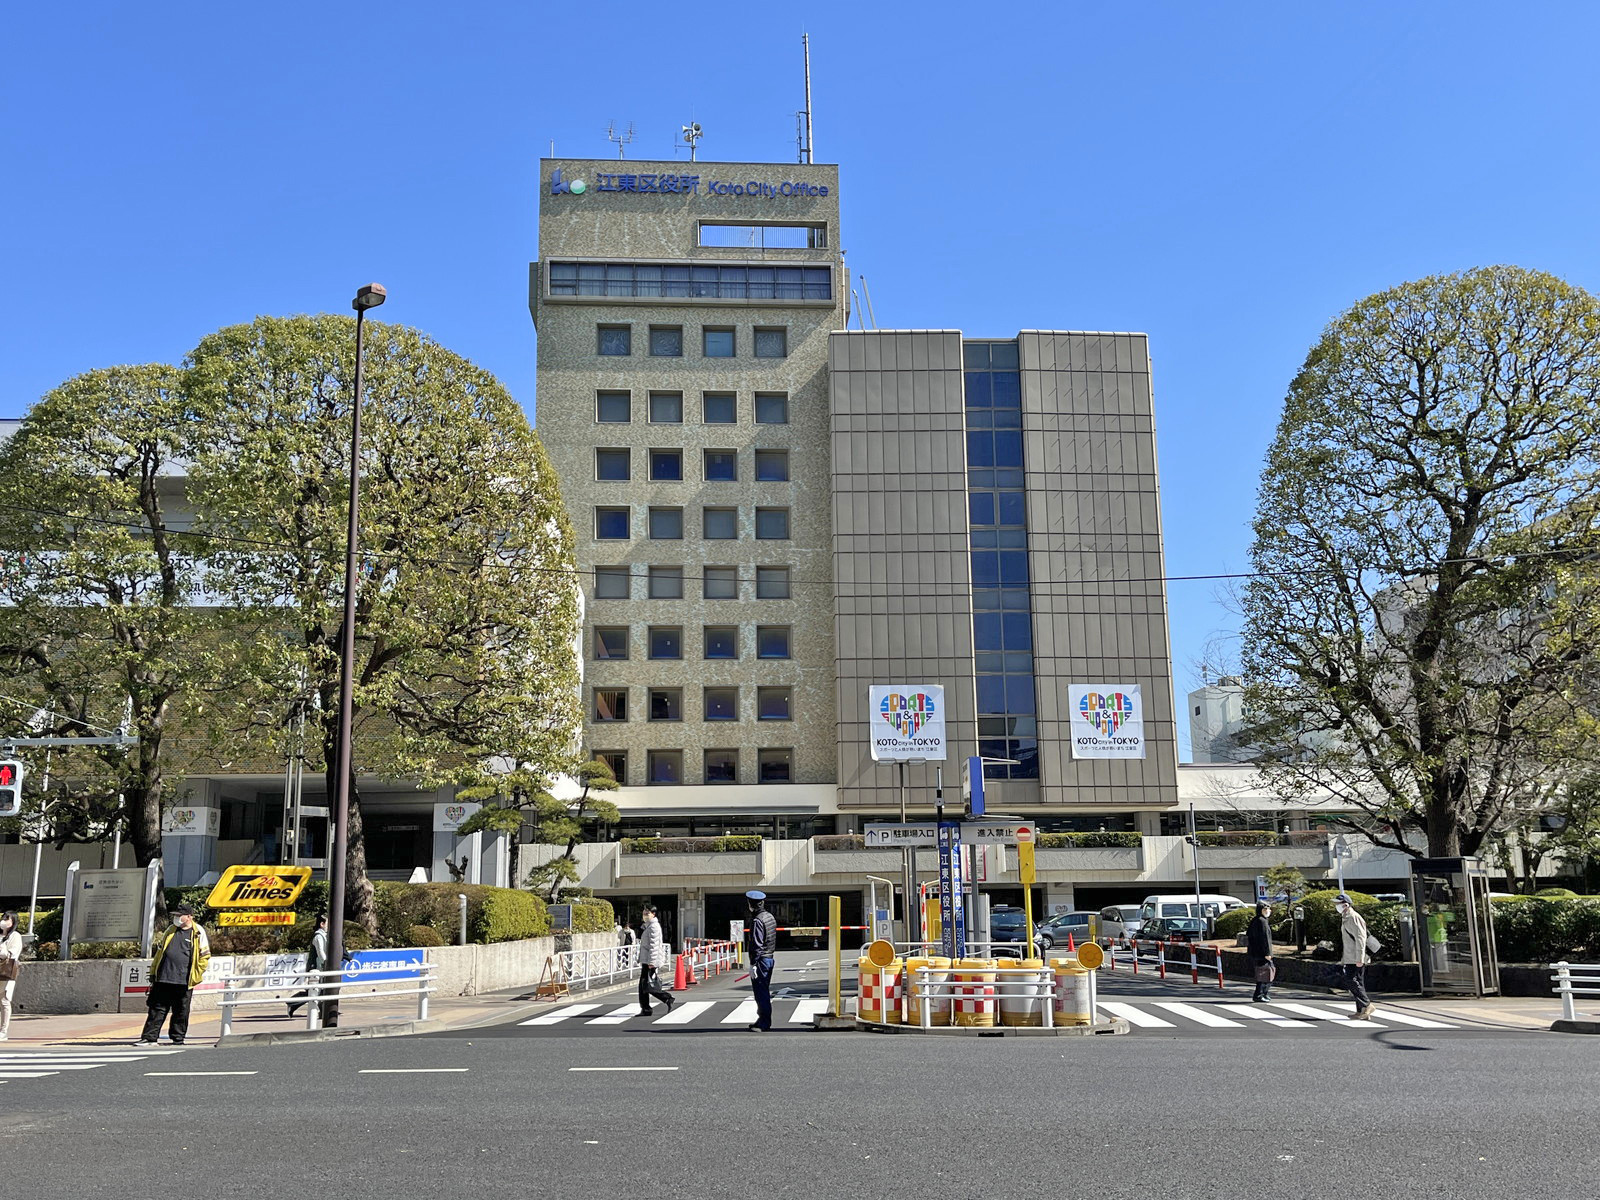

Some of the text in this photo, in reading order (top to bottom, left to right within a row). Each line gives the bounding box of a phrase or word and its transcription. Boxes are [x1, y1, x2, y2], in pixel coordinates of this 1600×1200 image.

[596, 172, 700, 194] 江東区役所
[708, 180, 829, 199] Koto City Office
[880, 693, 935, 712] SPORTS
[1079, 692, 1133, 711] SPORTS
[877, 738, 898, 746] KOTO
[912, 738, 941, 746] TOKYO
[1077, 737, 1098, 745] KOTO
[1112, 737, 1139, 745] TOKYO
[881, 831, 890, 842] P
[893, 829, 935, 839] 駐車場入口
[977, 828, 1014, 838] 進入禁止
[228, 882, 294, 902] Times
[941, 854, 951, 922] 江東区役所
[953, 854, 963, 922] 江東区役所
[881, 923, 888, 934] P
